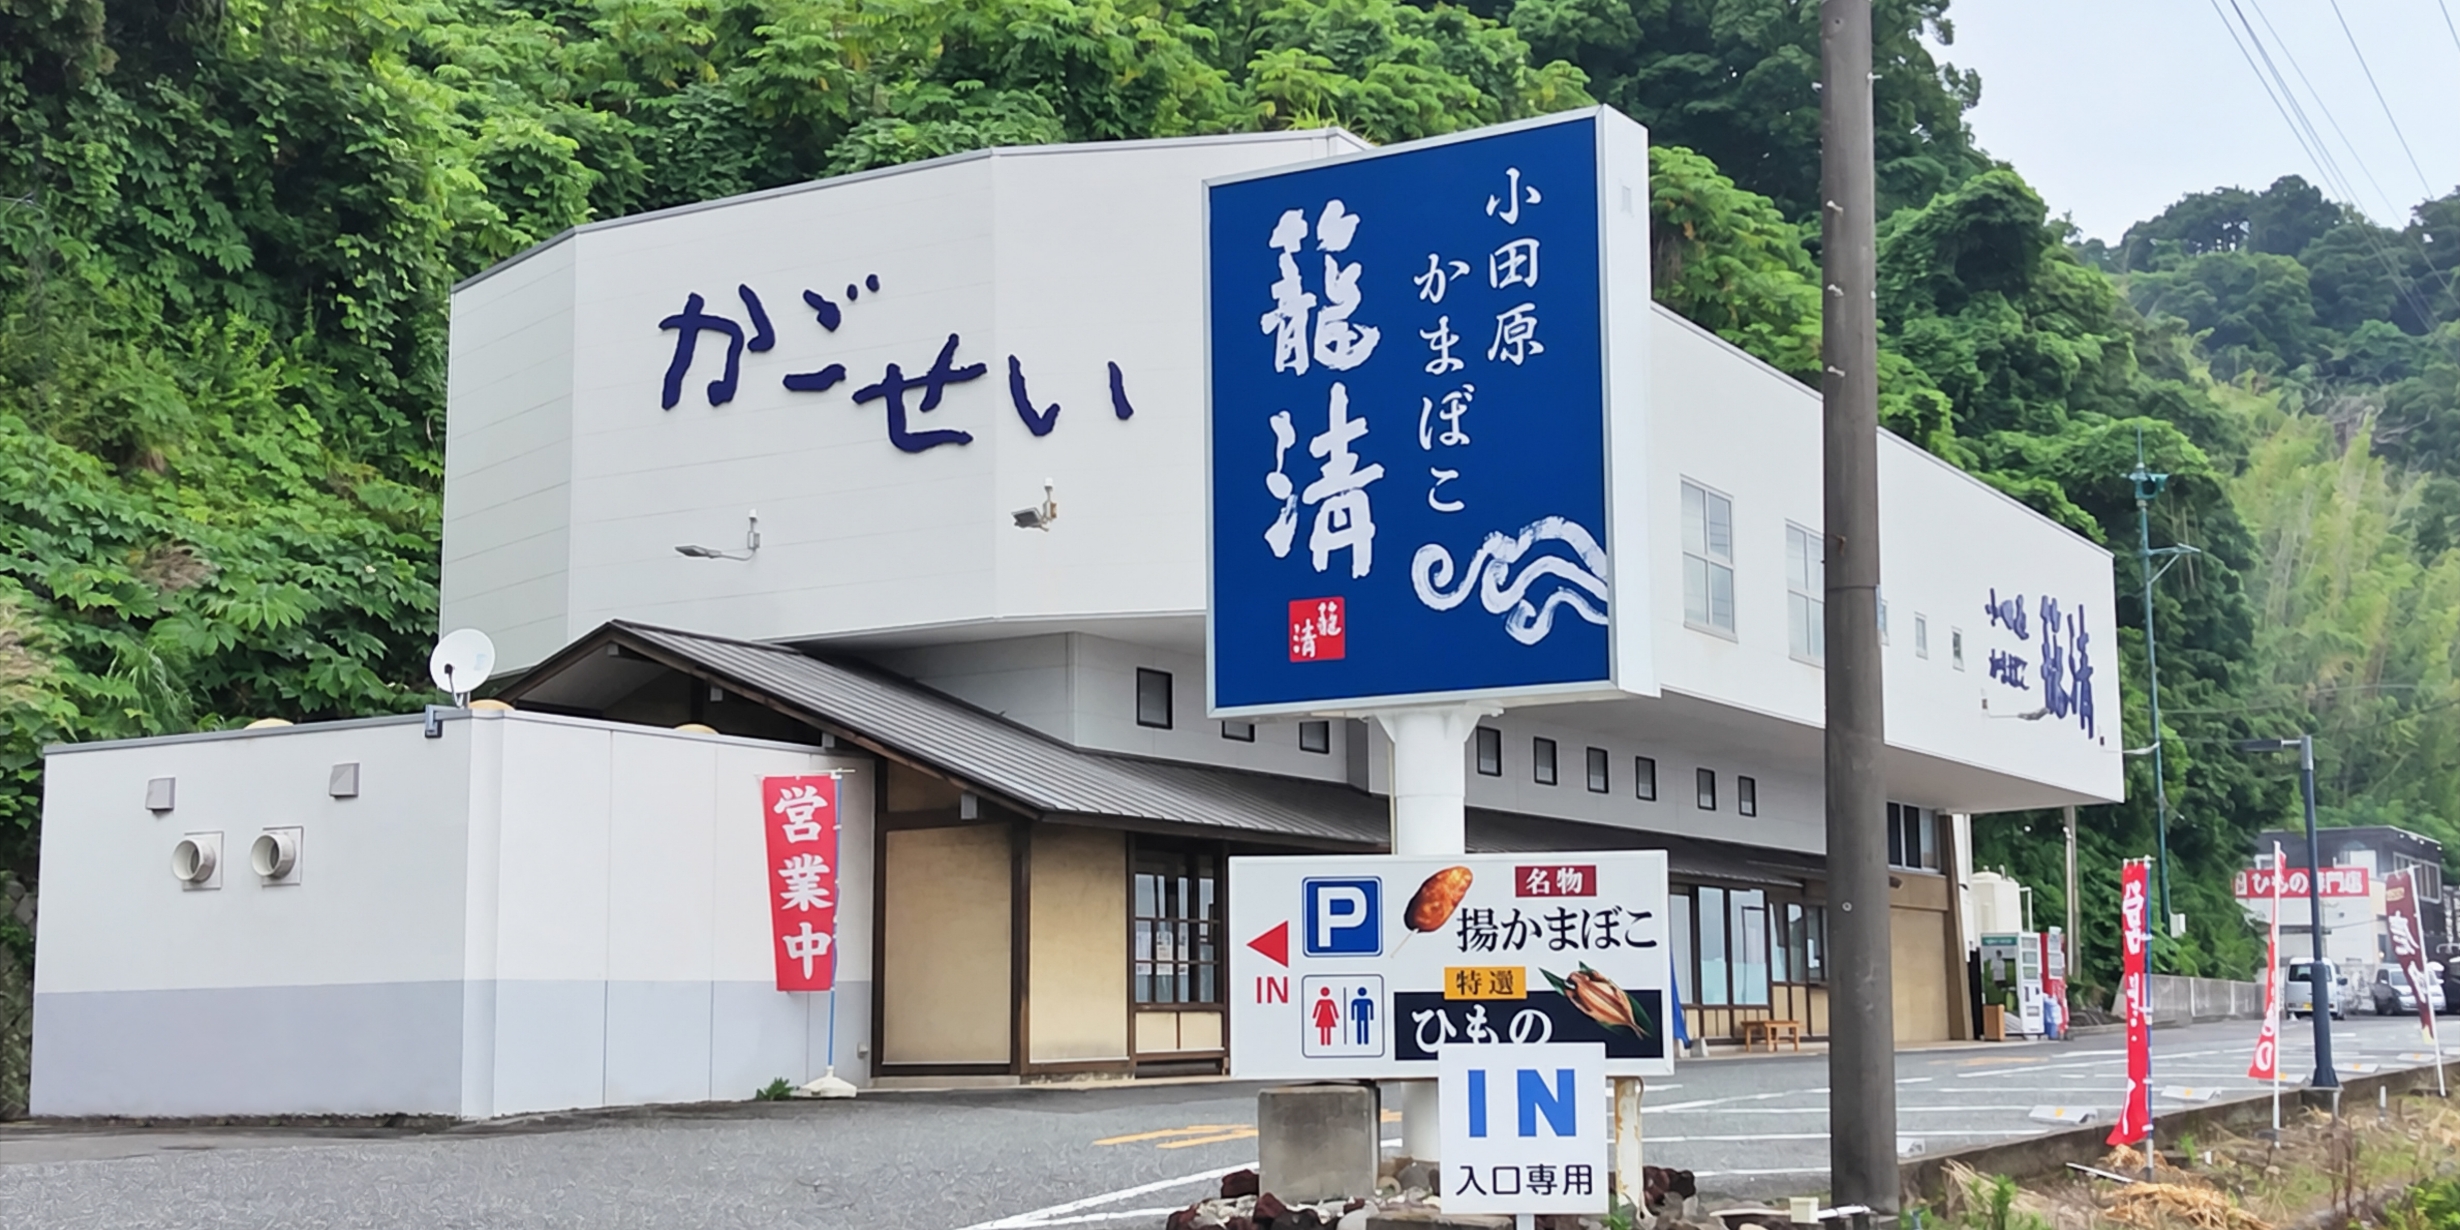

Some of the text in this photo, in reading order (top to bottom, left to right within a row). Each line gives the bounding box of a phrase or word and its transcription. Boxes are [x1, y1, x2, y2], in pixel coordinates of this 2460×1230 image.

[1486, 167, 1543, 366] 小田原
[659, 274, 1134, 452] かごせい
[1260, 199, 1384, 579] 籠清
[1413, 253, 1474, 513] かまぼこ
[773, 785, 834, 980] 営業中
[1526, 868, 1584, 896] 名物
[1317, 886, 1368, 948] P
[1456, 906, 1658, 953] 揚かまぼこ
[1256, 976, 1289, 1004] IN
[1455, 969, 1515, 996] 特選
[1411, 1003, 1553, 1053] ひもの
[1467, 1069, 1577, 1138] IN
[1455, 1164, 1594, 1196] 入口専用
